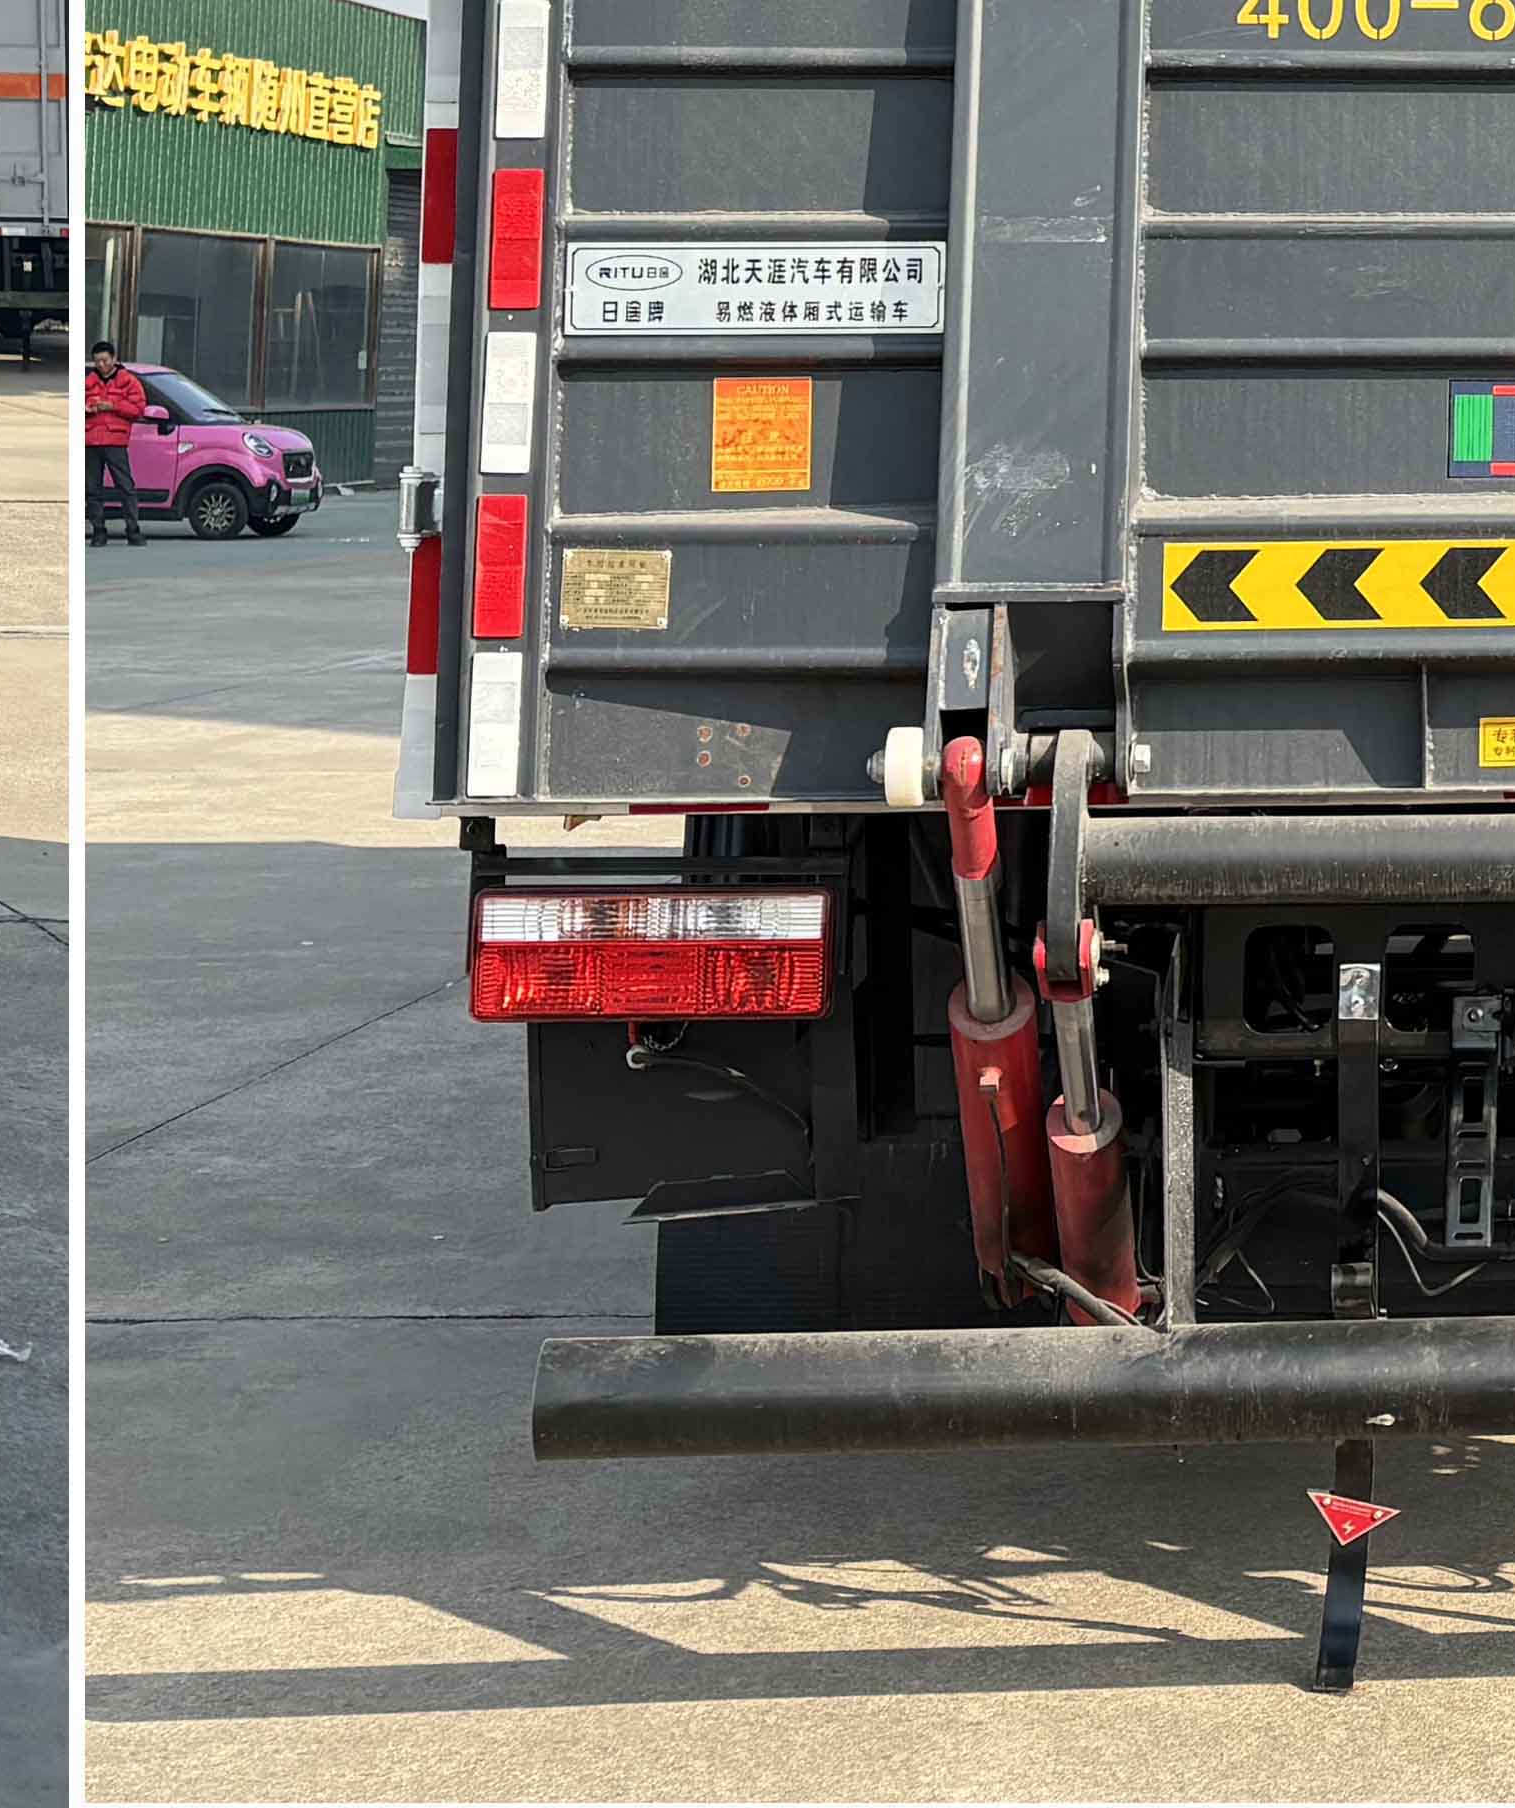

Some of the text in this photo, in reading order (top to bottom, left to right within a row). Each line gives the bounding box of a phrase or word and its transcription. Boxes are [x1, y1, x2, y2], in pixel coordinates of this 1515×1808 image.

[85, 29, 382, 150] 达电动车辆随州直营店
[697, 256, 925, 285] 湖北天涯汽车有限公司
[715, 299, 910, 324] 易燃液体厢式运输车
